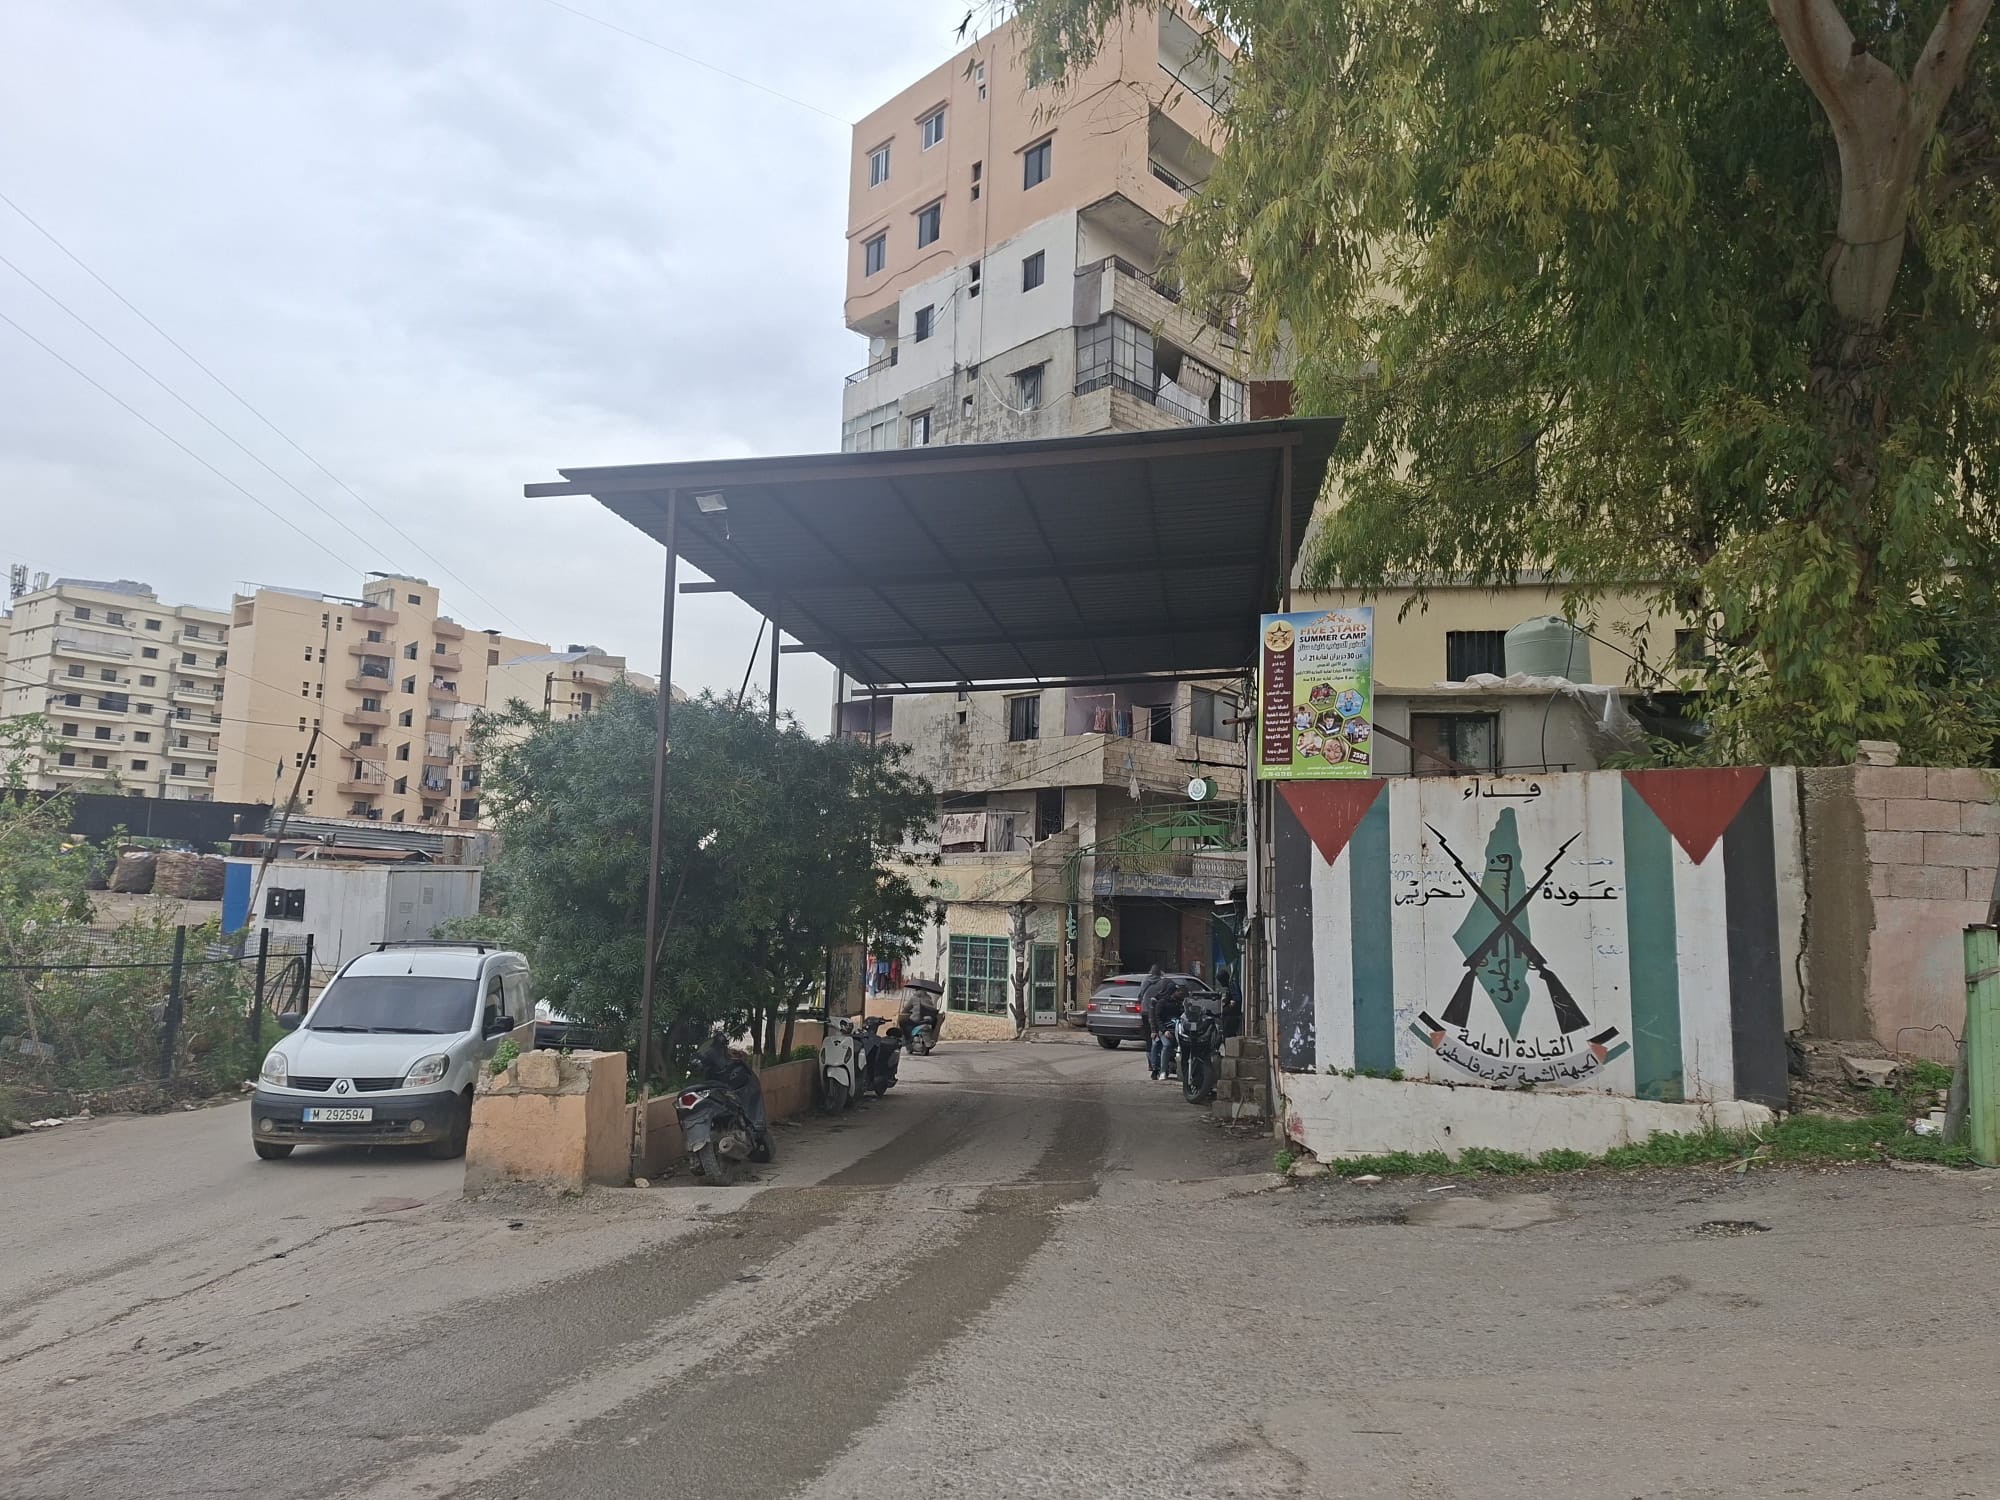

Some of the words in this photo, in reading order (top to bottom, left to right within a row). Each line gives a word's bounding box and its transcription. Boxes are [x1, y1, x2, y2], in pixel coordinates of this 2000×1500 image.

[1299, 634, 1337, 642] SUMMER
[1340, 632, 1367, 640] CAMP
[1300, 627, 1326, 635] FIVE
[1329, 624, 1367, 633] STARS
[1488, 853, 1520, 1003] فلسطين
[1457, 1028, 1510, 1059] العامة
[1515, 1035, 1574, 1061] القيادة
[1435, 1043, 1481, 1073] فلسطين
[1559, 1053, 1599, 1078] الجبهة
[313, 1109, 320, 1120] M
[326, 1109, 365, 1121] 292594
